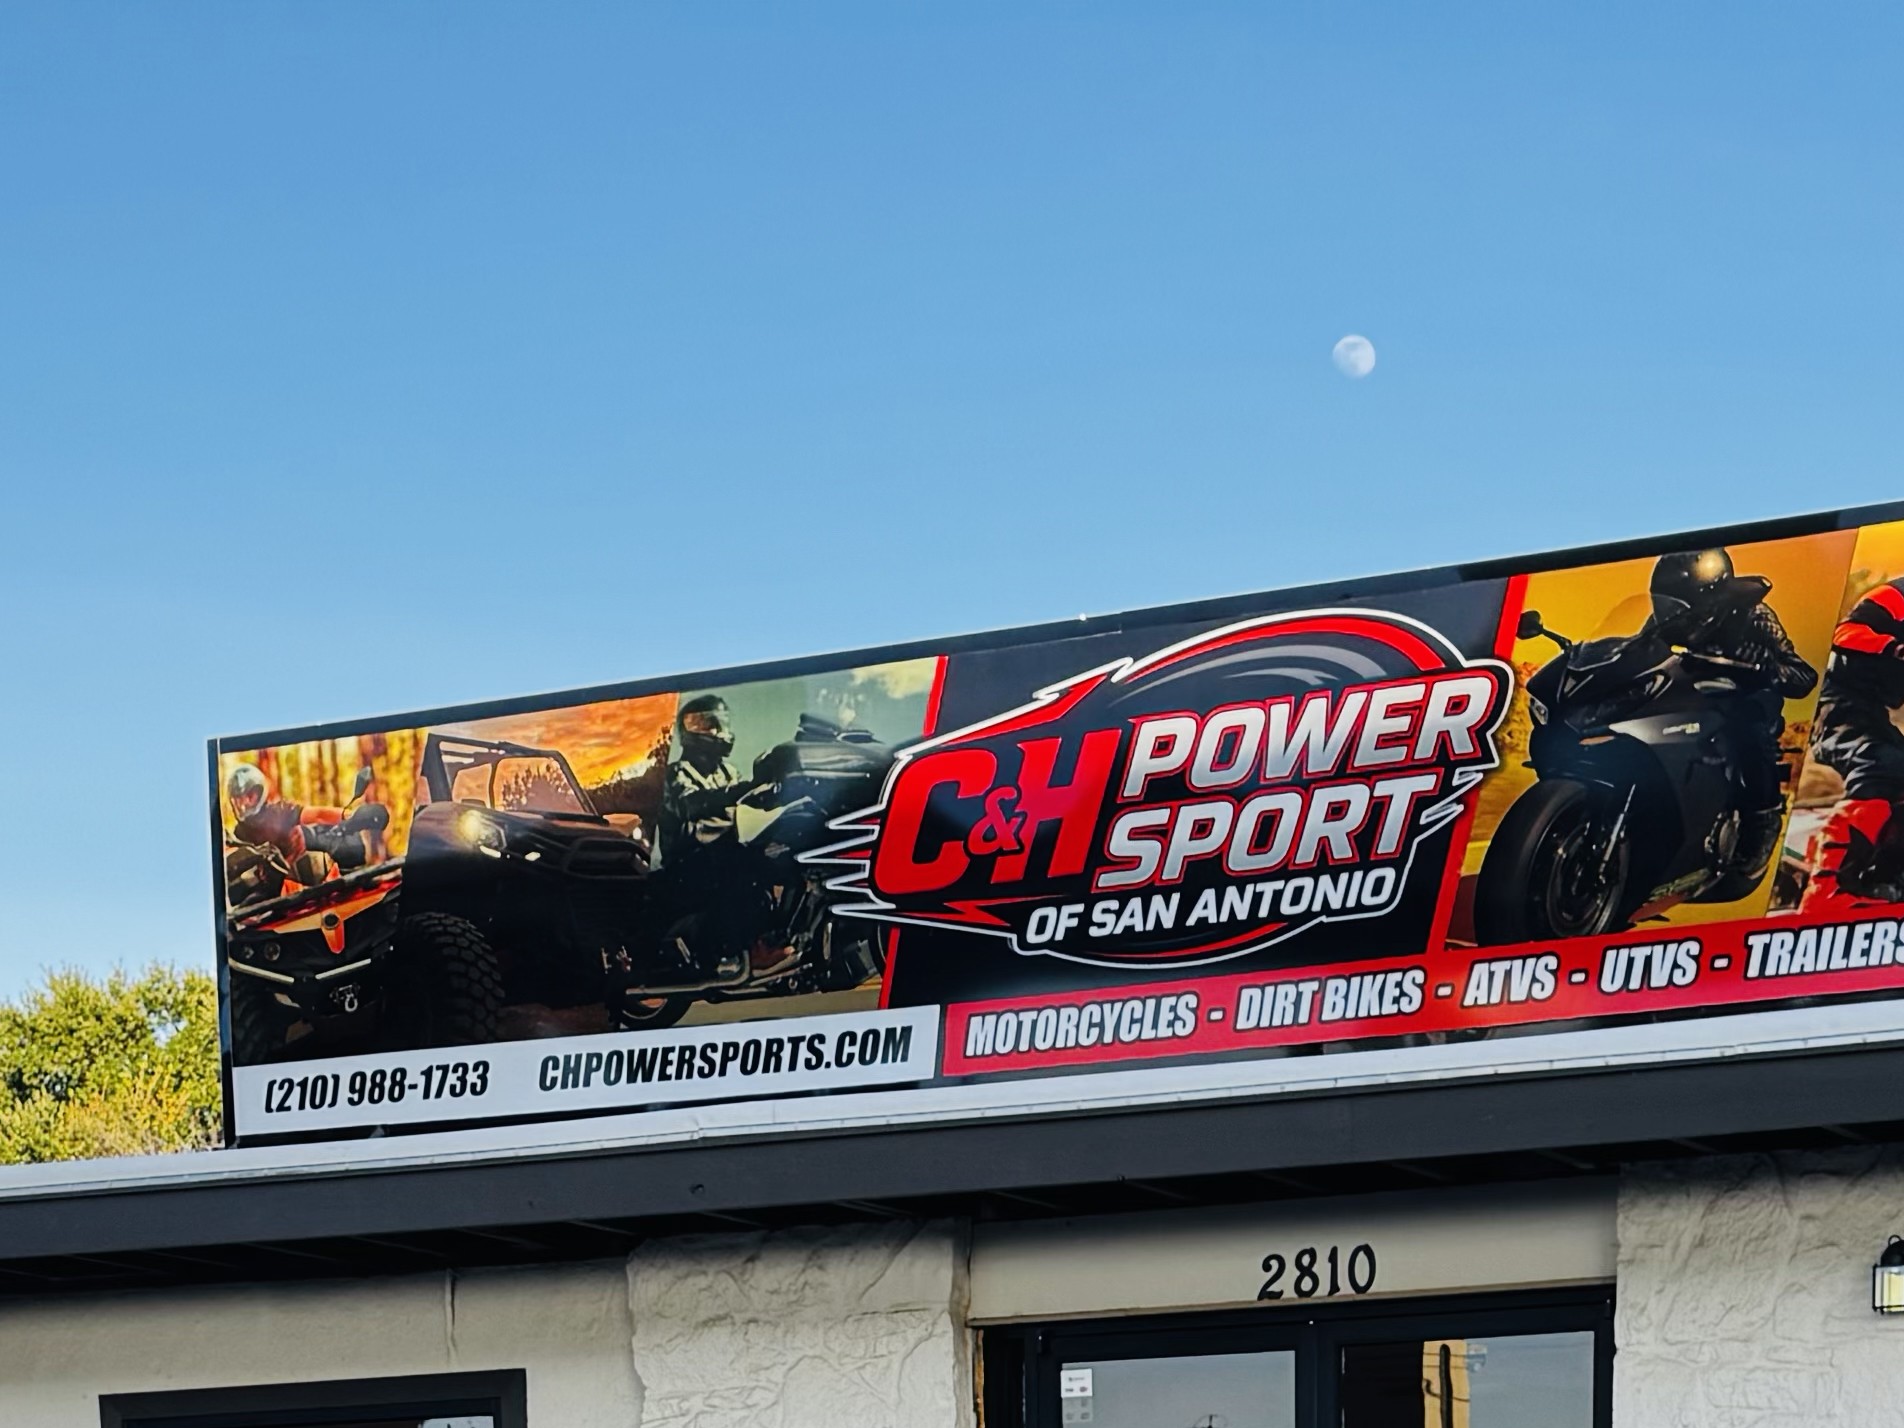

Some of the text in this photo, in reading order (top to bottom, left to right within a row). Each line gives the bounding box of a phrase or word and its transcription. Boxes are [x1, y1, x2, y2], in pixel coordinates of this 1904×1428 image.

[1124, 675, 1493, 799] POWER
[873, 728, 1122, 897] C&H
[1097, 774, 1439, 889] SPORT
[1026, 865, 1398, 945] OF SAN ANTONIO
[965, 994, 1197, 1058] MOTORCYCLES
[1236, 982, 1319, 1031] DIRT
[1320, 970, 1424, 1022] BIKES
[1463, 955, 1557, 1008] ATVS
[1600, 940, 1700, 994] UTVS
[264, 1025, 913, 1113] (210) 988-1733 CHPOWERSPORTS.COM
[1257, 1244, 1377, 1300] 2810
